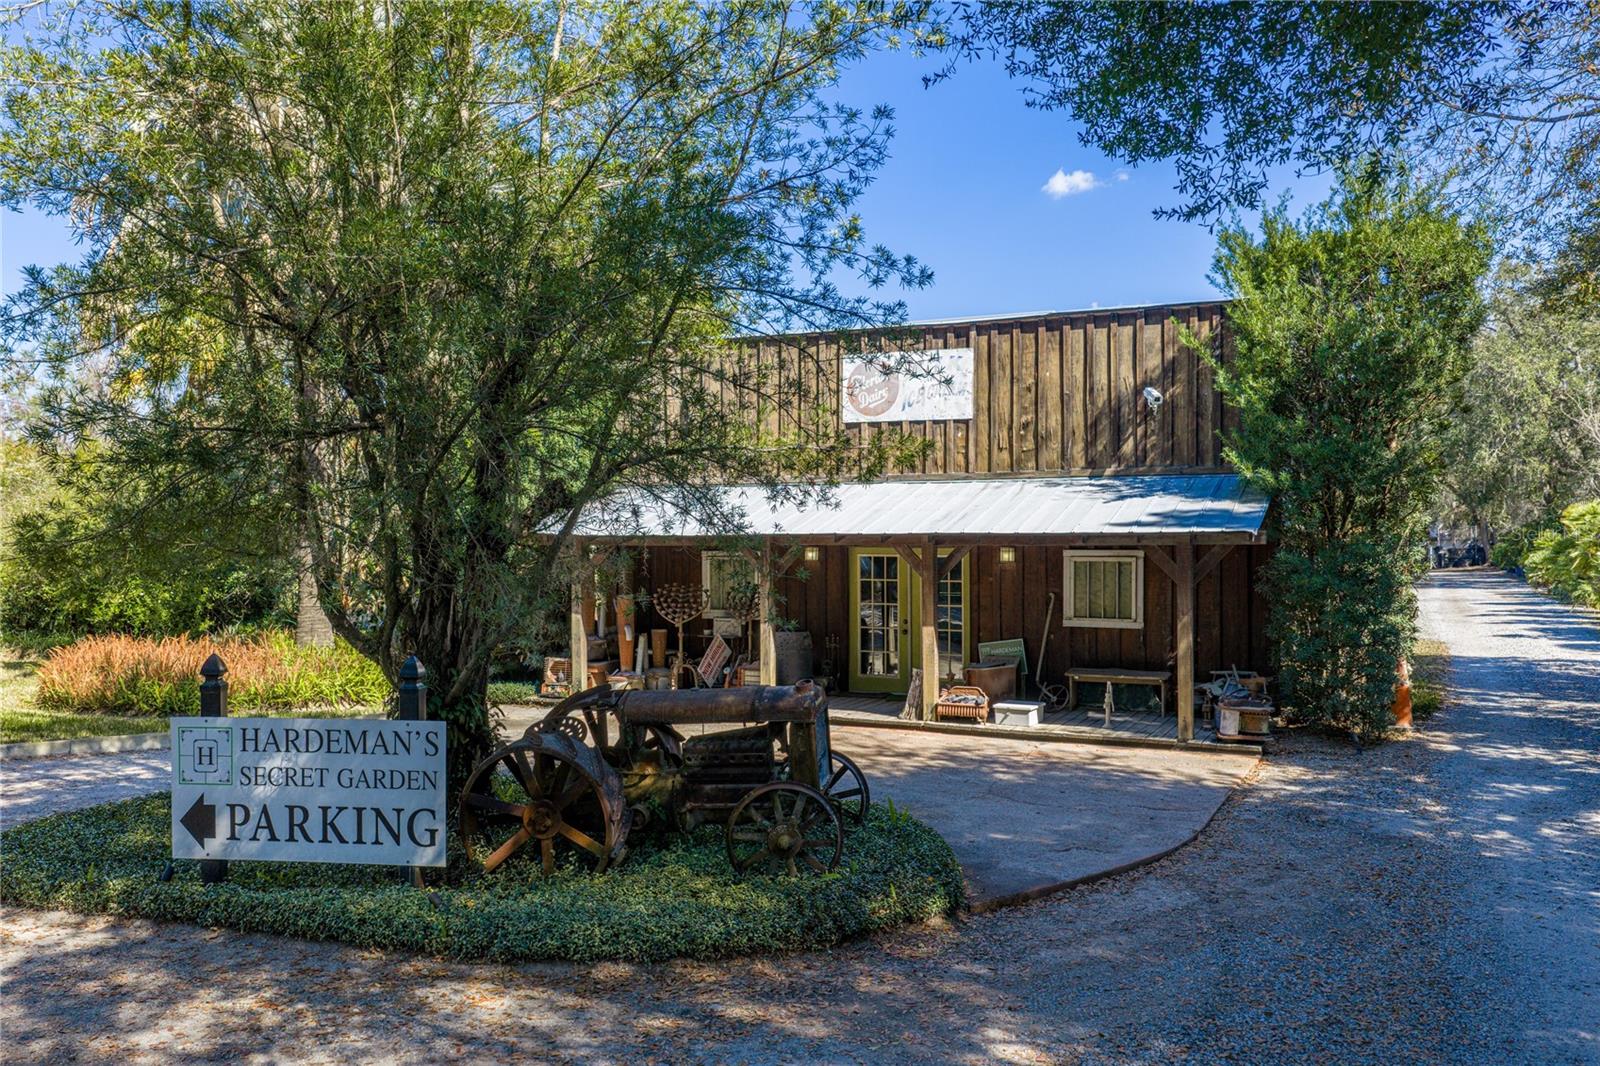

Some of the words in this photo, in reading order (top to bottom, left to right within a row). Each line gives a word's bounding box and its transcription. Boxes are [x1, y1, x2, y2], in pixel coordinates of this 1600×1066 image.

[240, 728, 439, 757] HARDEMAN'S
[197, 746, 213, 766] H
[239, 766, 329, 788] SECRET
[337, 768, 439, 790] GARDEN
[226, 803, 439, 848] PARKING
